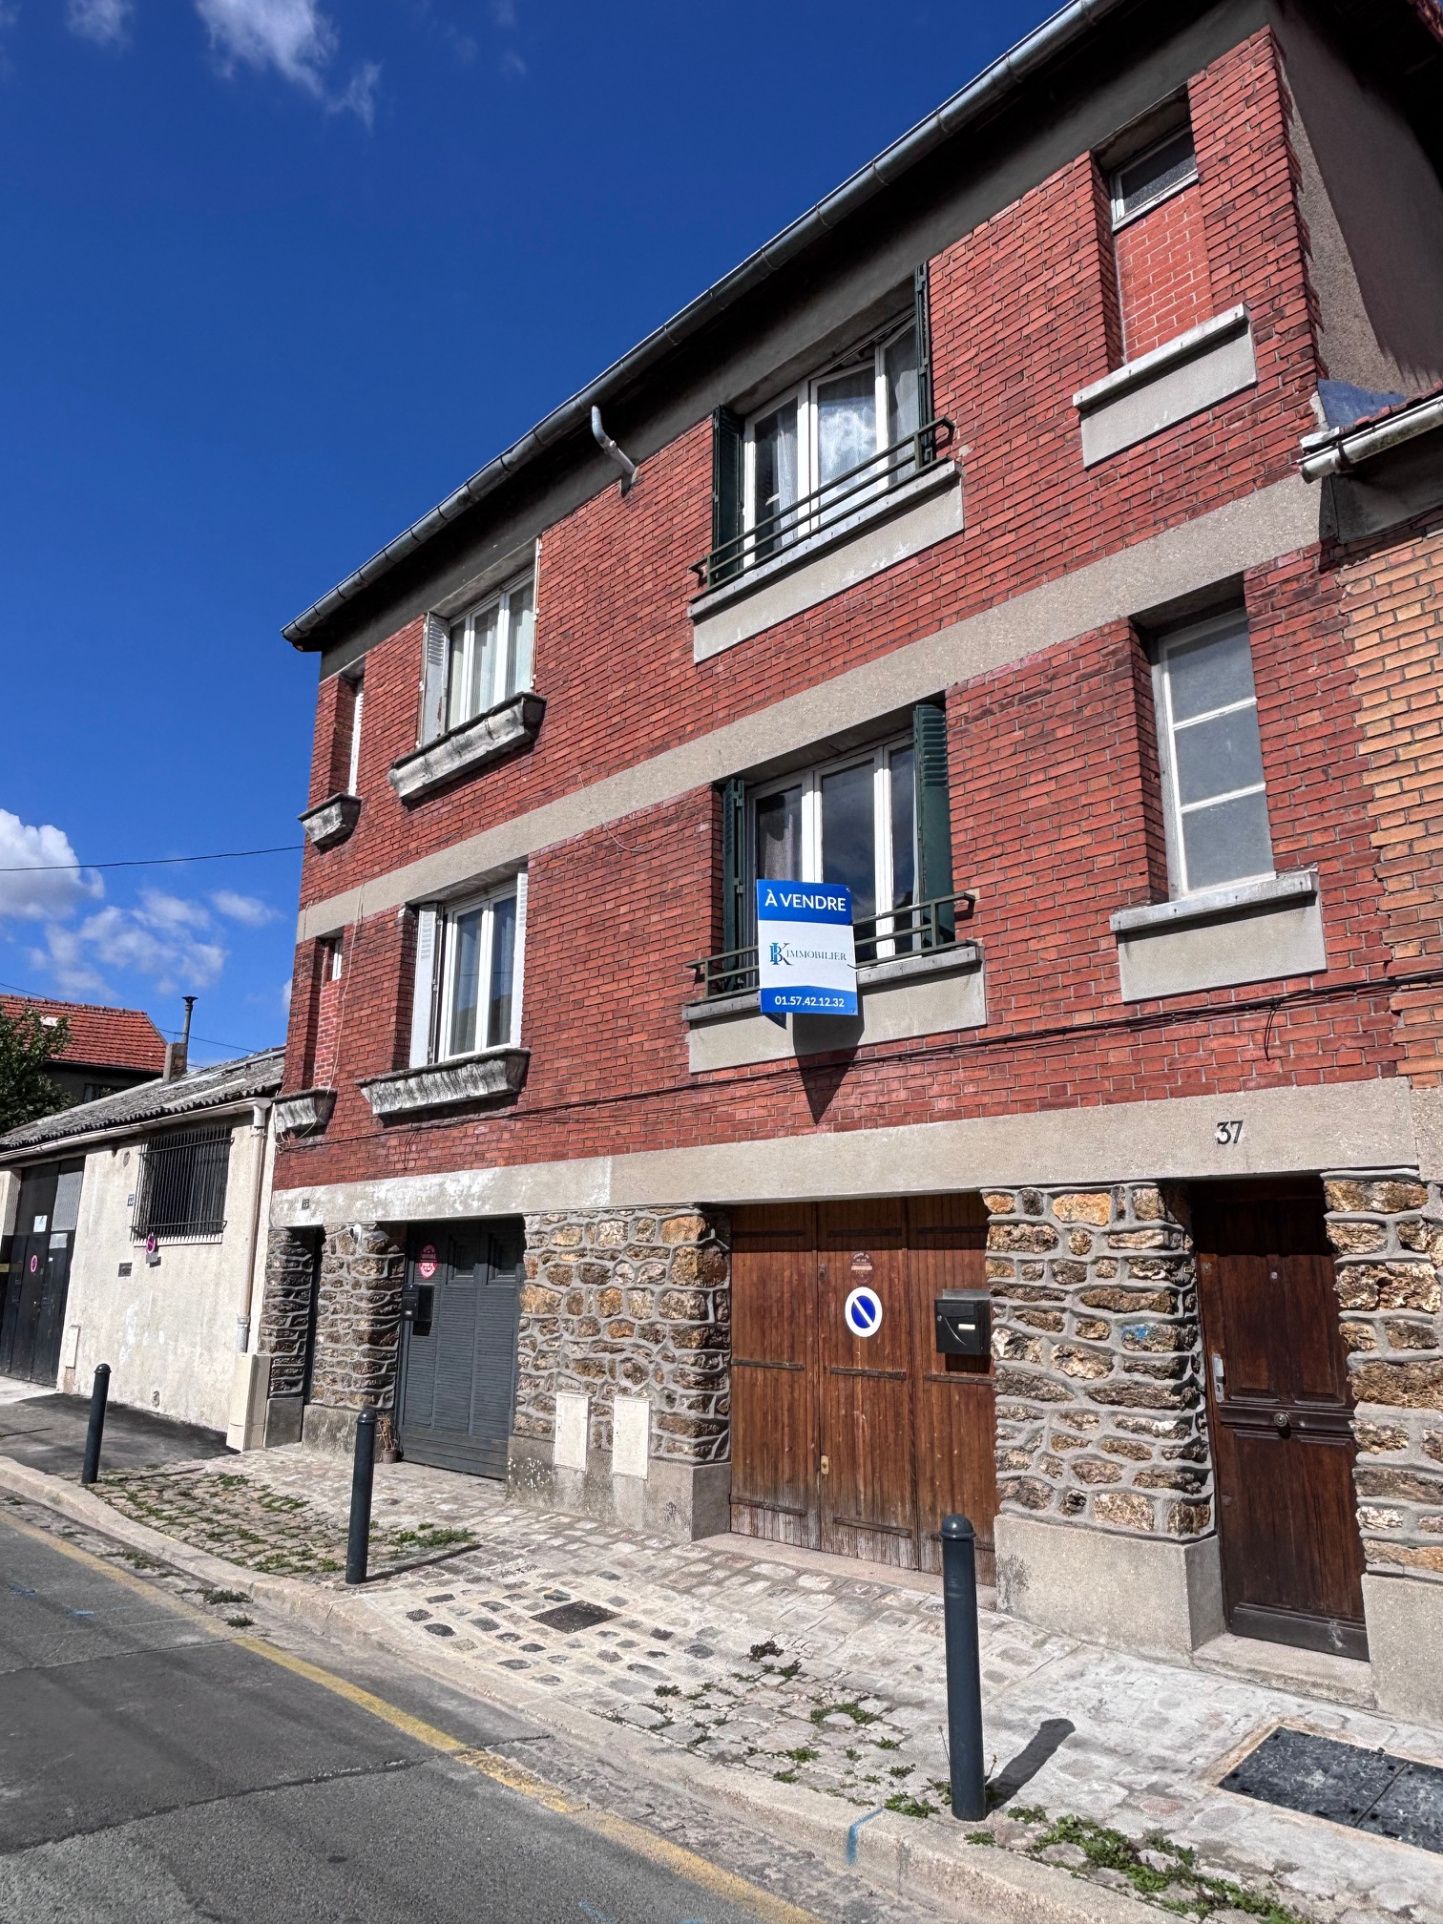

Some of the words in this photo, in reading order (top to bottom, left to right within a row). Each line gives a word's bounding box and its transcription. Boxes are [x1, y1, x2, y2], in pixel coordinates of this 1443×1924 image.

[764, 888, 778, 907] À
[780, 893, 847, 912] VENDRE
[786, 950, 847, 961] IMMOBILIER
[775, 995, 845, 1008] 01.57.42.12.32
[1216, 1120, 1244, 1145] 37
